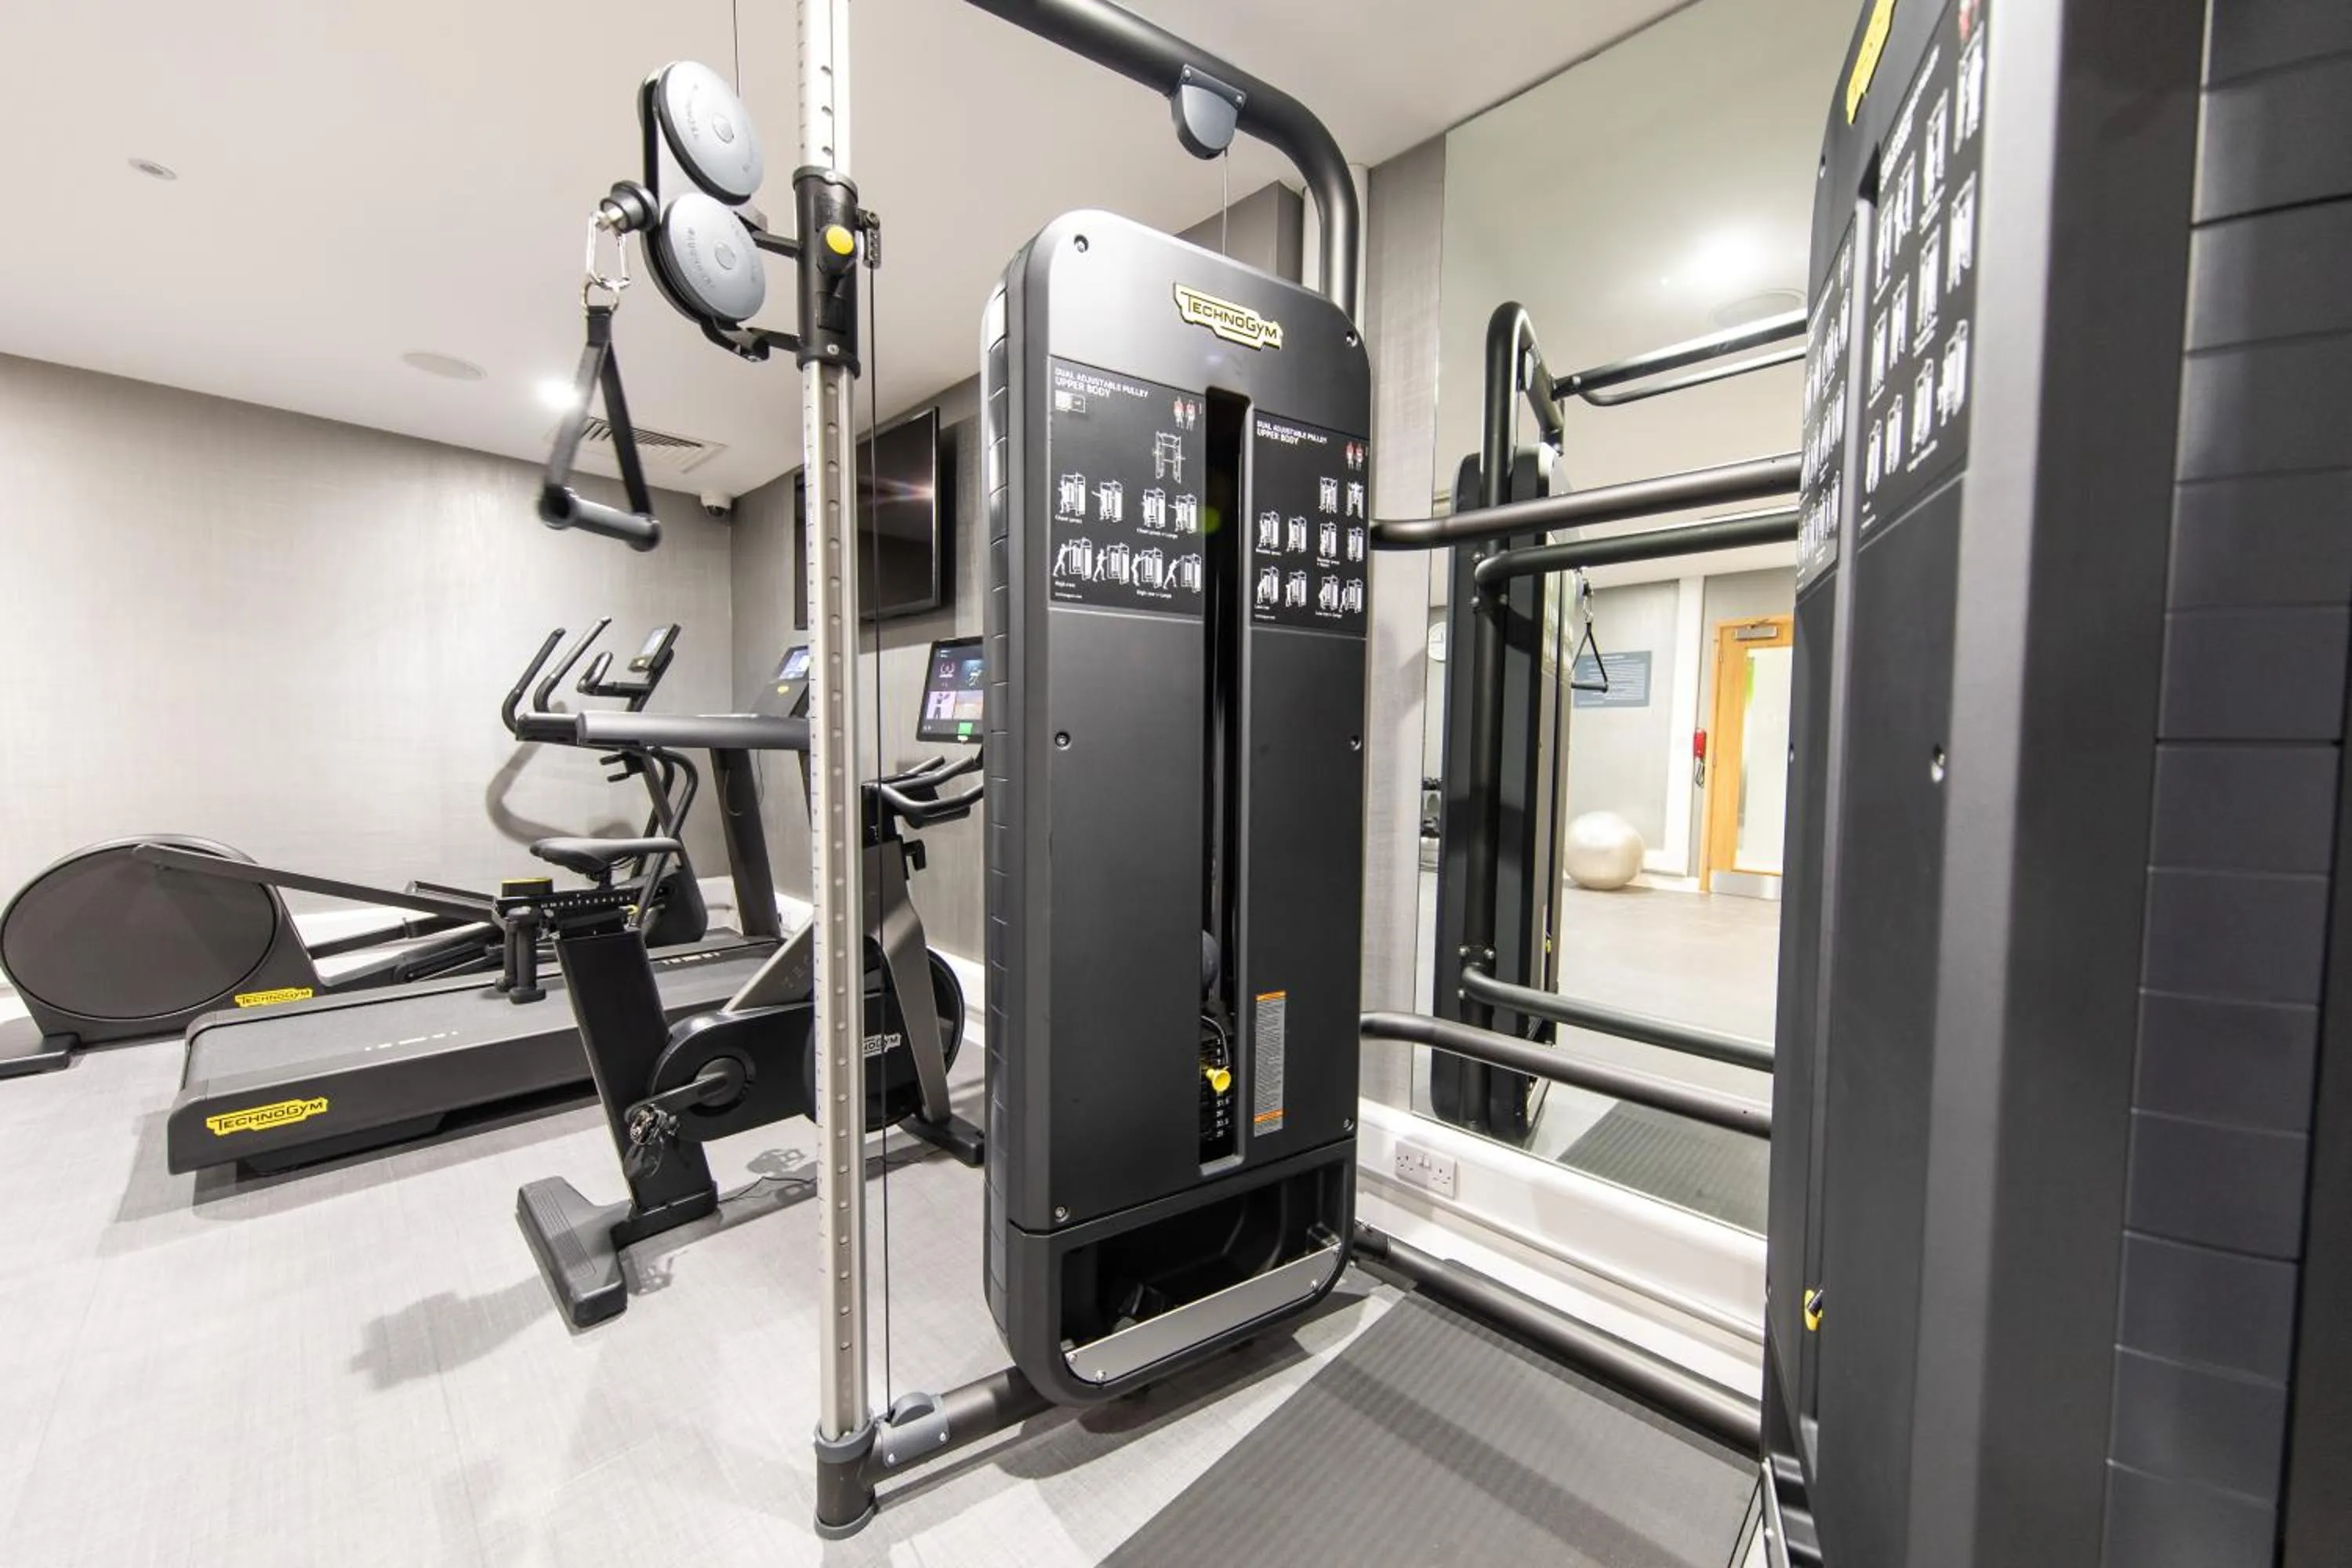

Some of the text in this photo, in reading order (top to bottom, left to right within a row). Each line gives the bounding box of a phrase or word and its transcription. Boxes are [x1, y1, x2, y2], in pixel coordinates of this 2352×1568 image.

[1178, 289, 1279, 341] TECHNOGYM
[1054, 376, 1111, 397] UPPER BODY
[208, 1101, 324, 1131] TECHNOGYM
